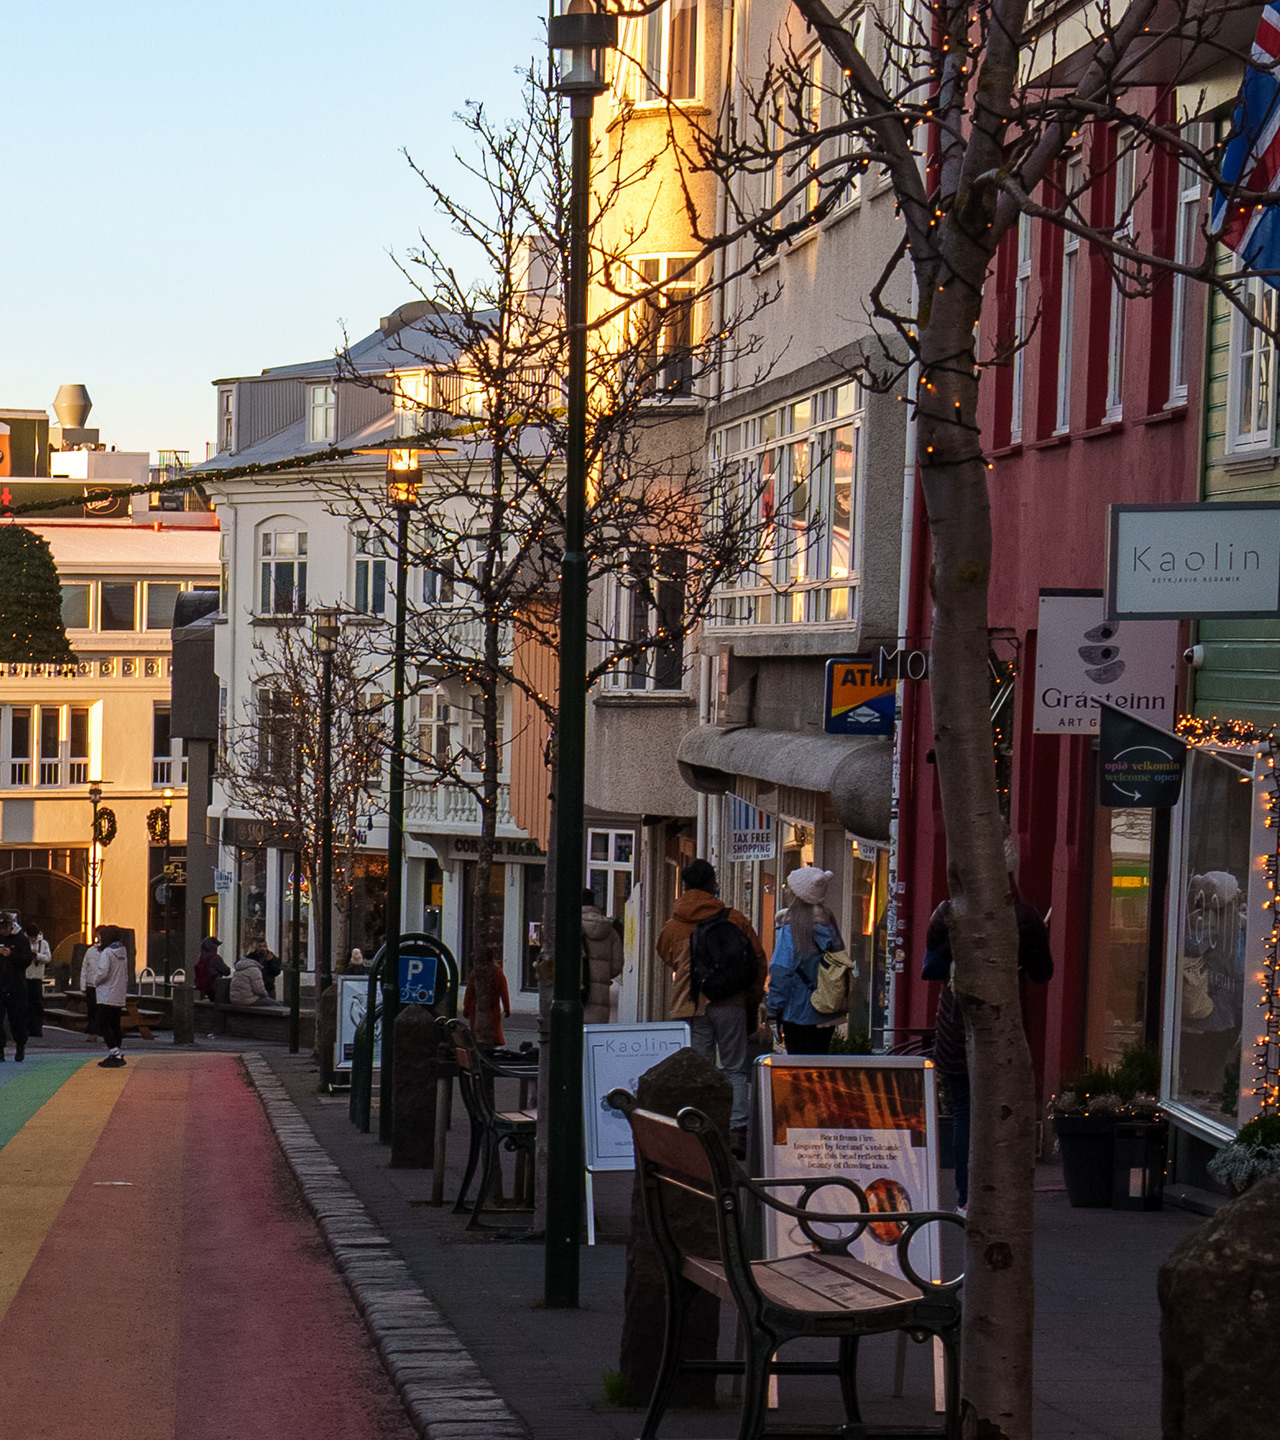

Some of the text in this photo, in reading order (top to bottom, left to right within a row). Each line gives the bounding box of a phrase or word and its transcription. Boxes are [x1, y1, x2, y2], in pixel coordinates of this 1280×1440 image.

[1133, 541, 1260, 572] Kaolin
[1041, 687, 1166, 710] Grásteinn
[1058, 717, 1084, 727] ART
[1132, 760, 1180, 771] velkomin
[1104, 772, 1179, 783] welcome open
[733, 832, 771, 843] TAX FREE
[732, 843, 771, 854] SHOPPING
[406, 959, 424, 981] P
[605, 1037, 669, 1053] Kaolin
[819, 1133, 839, 1142] Born
[839, 1134, 858, 1142] from
[793, 1142, 824, 1151] Inspired
[825, 1142, 834, 1151] by
[870, 1142, 900, 1151] volcanic
[824, 1152, 838, 1160] this
[858, 1152, 885, 1160] reflects
[885, 1152, 898, 1161] the
[807, 1161, 833, 1170] beauty
[833, 1161, 842, 1169] of
[842, 1161, 872, 1170] flowing
